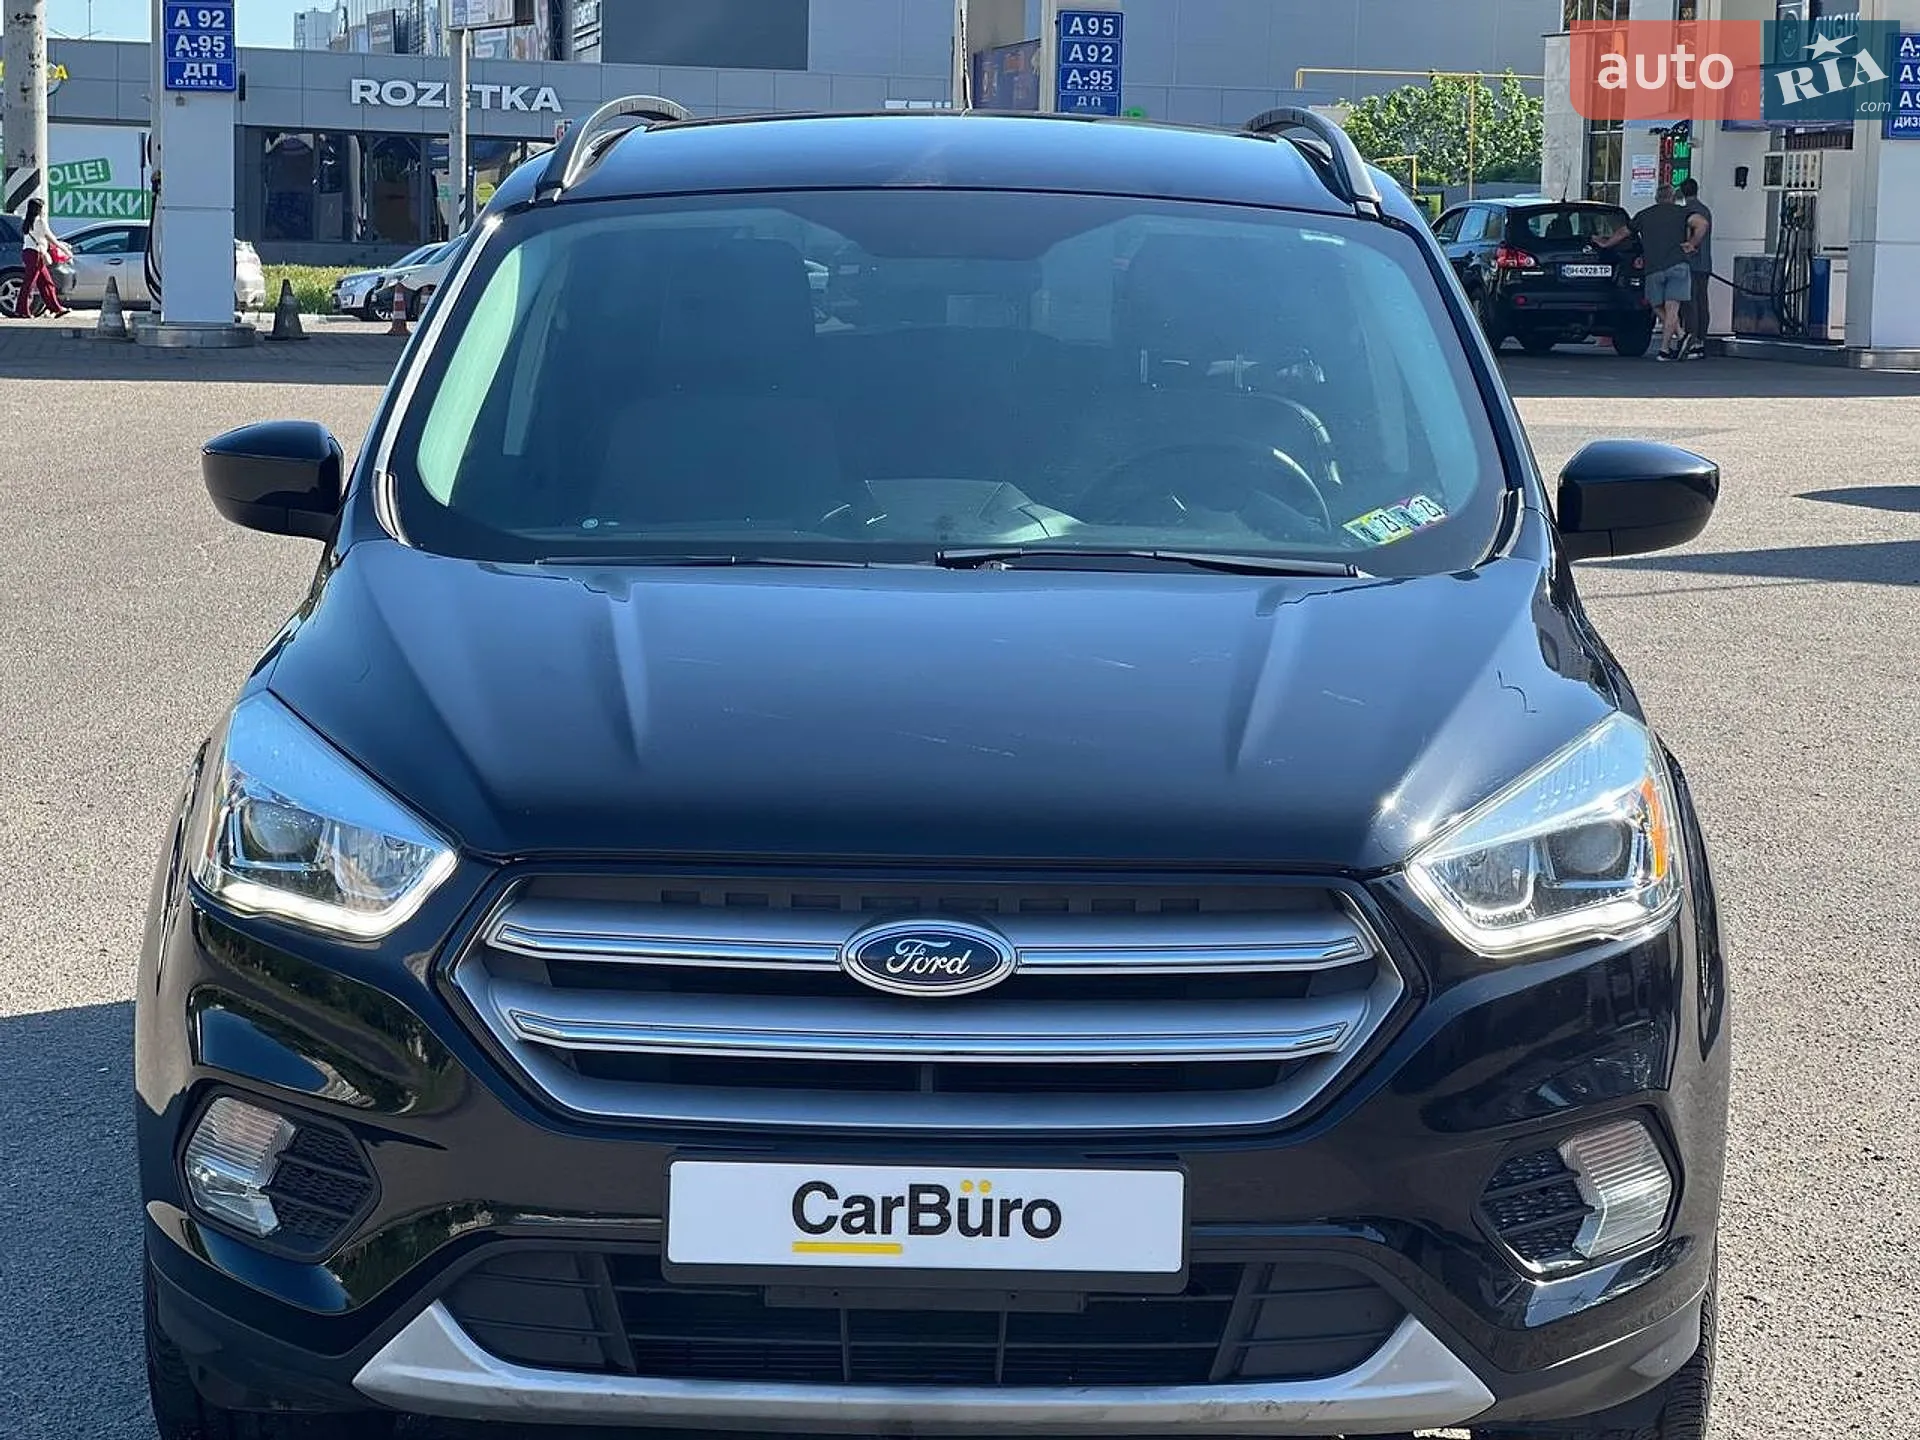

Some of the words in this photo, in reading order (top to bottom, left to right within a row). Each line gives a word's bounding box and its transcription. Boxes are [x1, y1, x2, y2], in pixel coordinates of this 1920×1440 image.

[198, 10, 225, 28] 92
[183, 63, 218, 78] ДП
[1893, 116, 1920, 129] ДИЗ
[52, 190, 147, 216] ИЖКИ
[886, 938, 972, 975] Ford
[791, 1179, 1062, 1240] CarBüro
